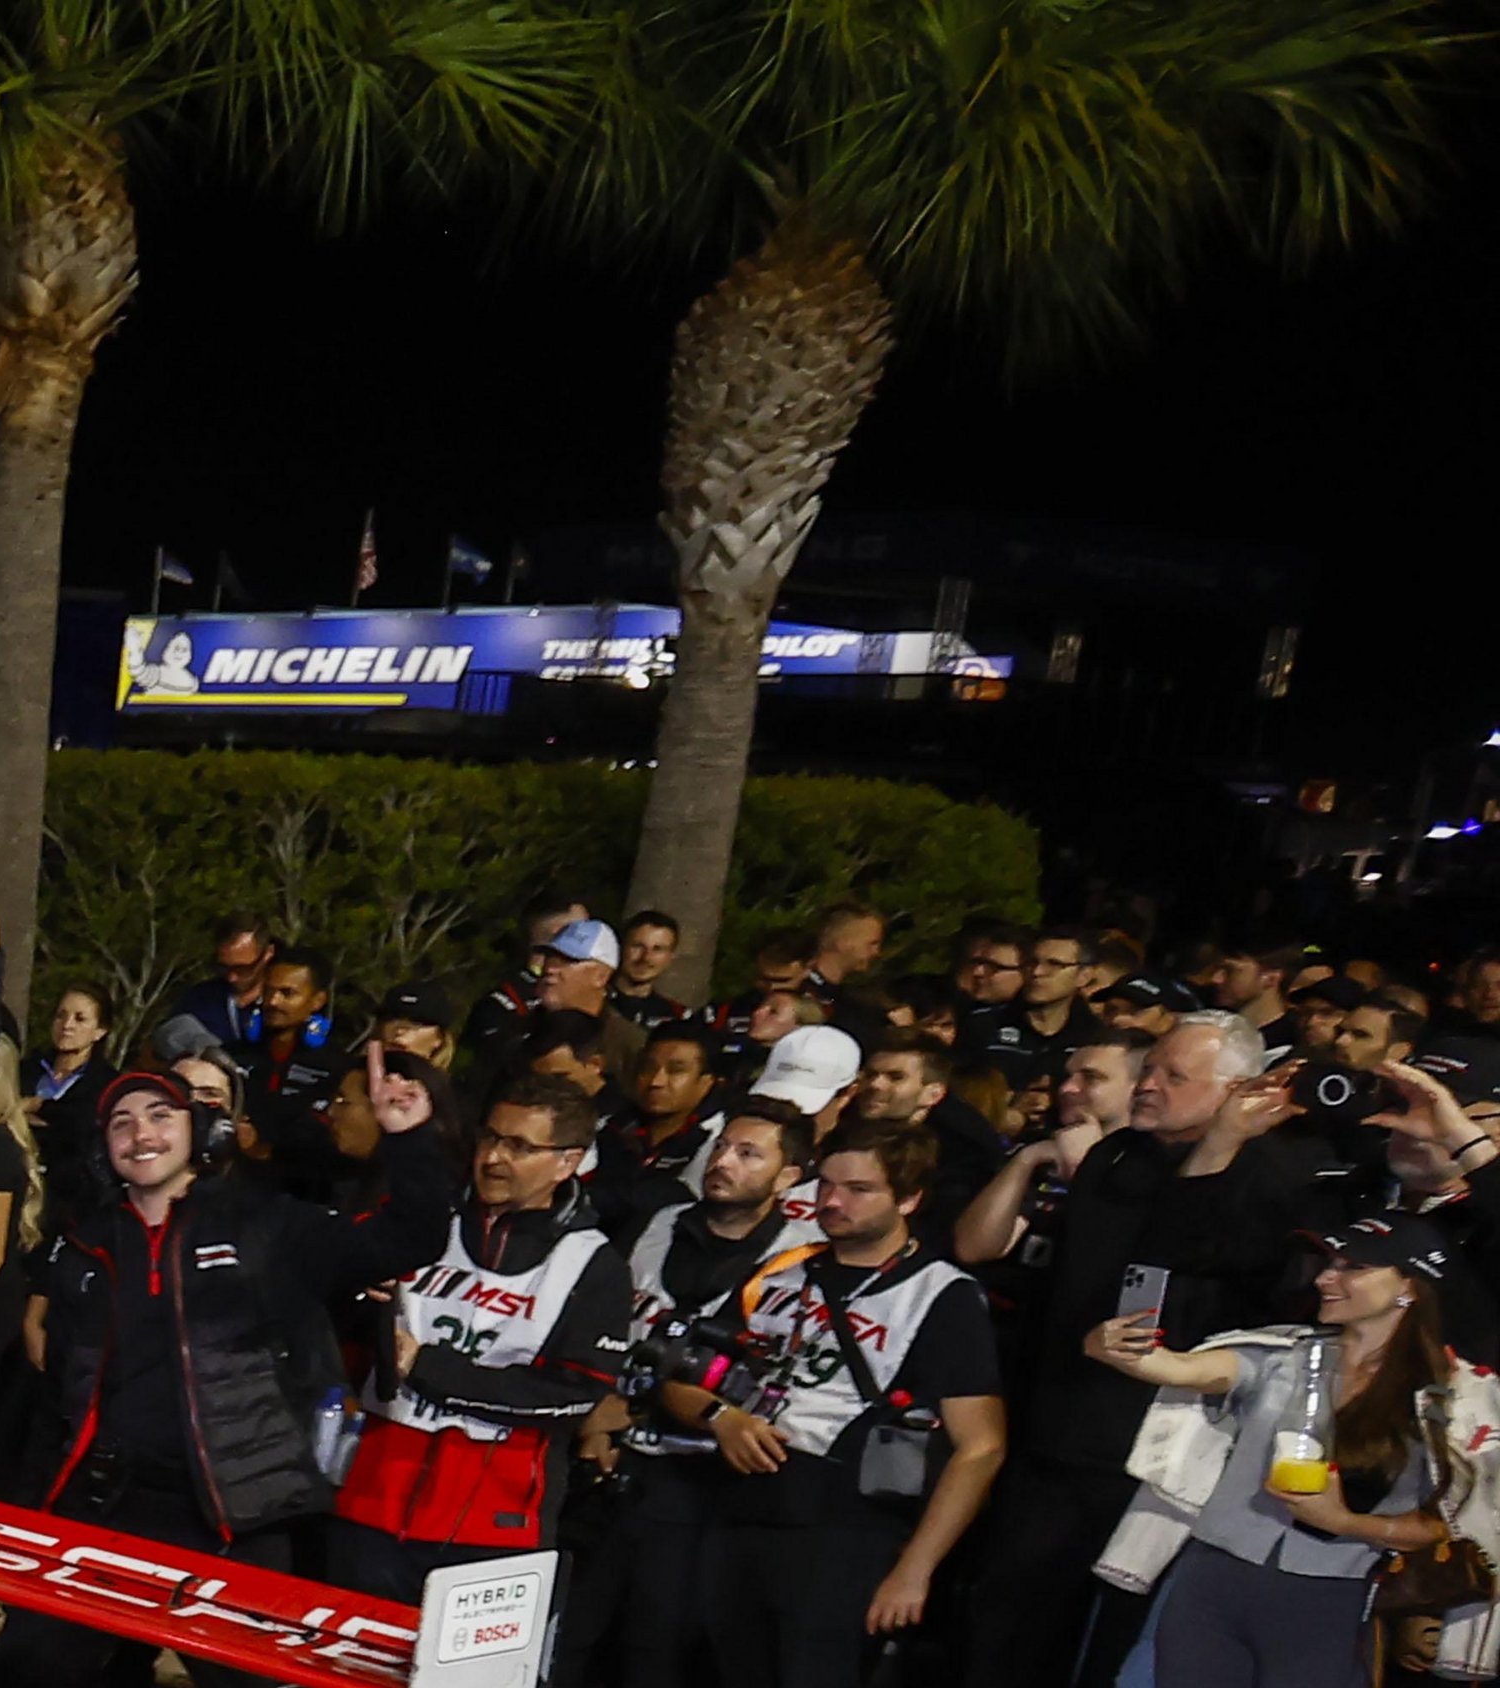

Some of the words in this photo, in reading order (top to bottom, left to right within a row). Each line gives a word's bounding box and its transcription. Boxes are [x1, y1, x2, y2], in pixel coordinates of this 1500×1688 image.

[203, 644, 473, 686] MICHELIN
[457, 1583, 527, 1609] HYBRID
[474, 1622, 521, 1645] BOSCH
